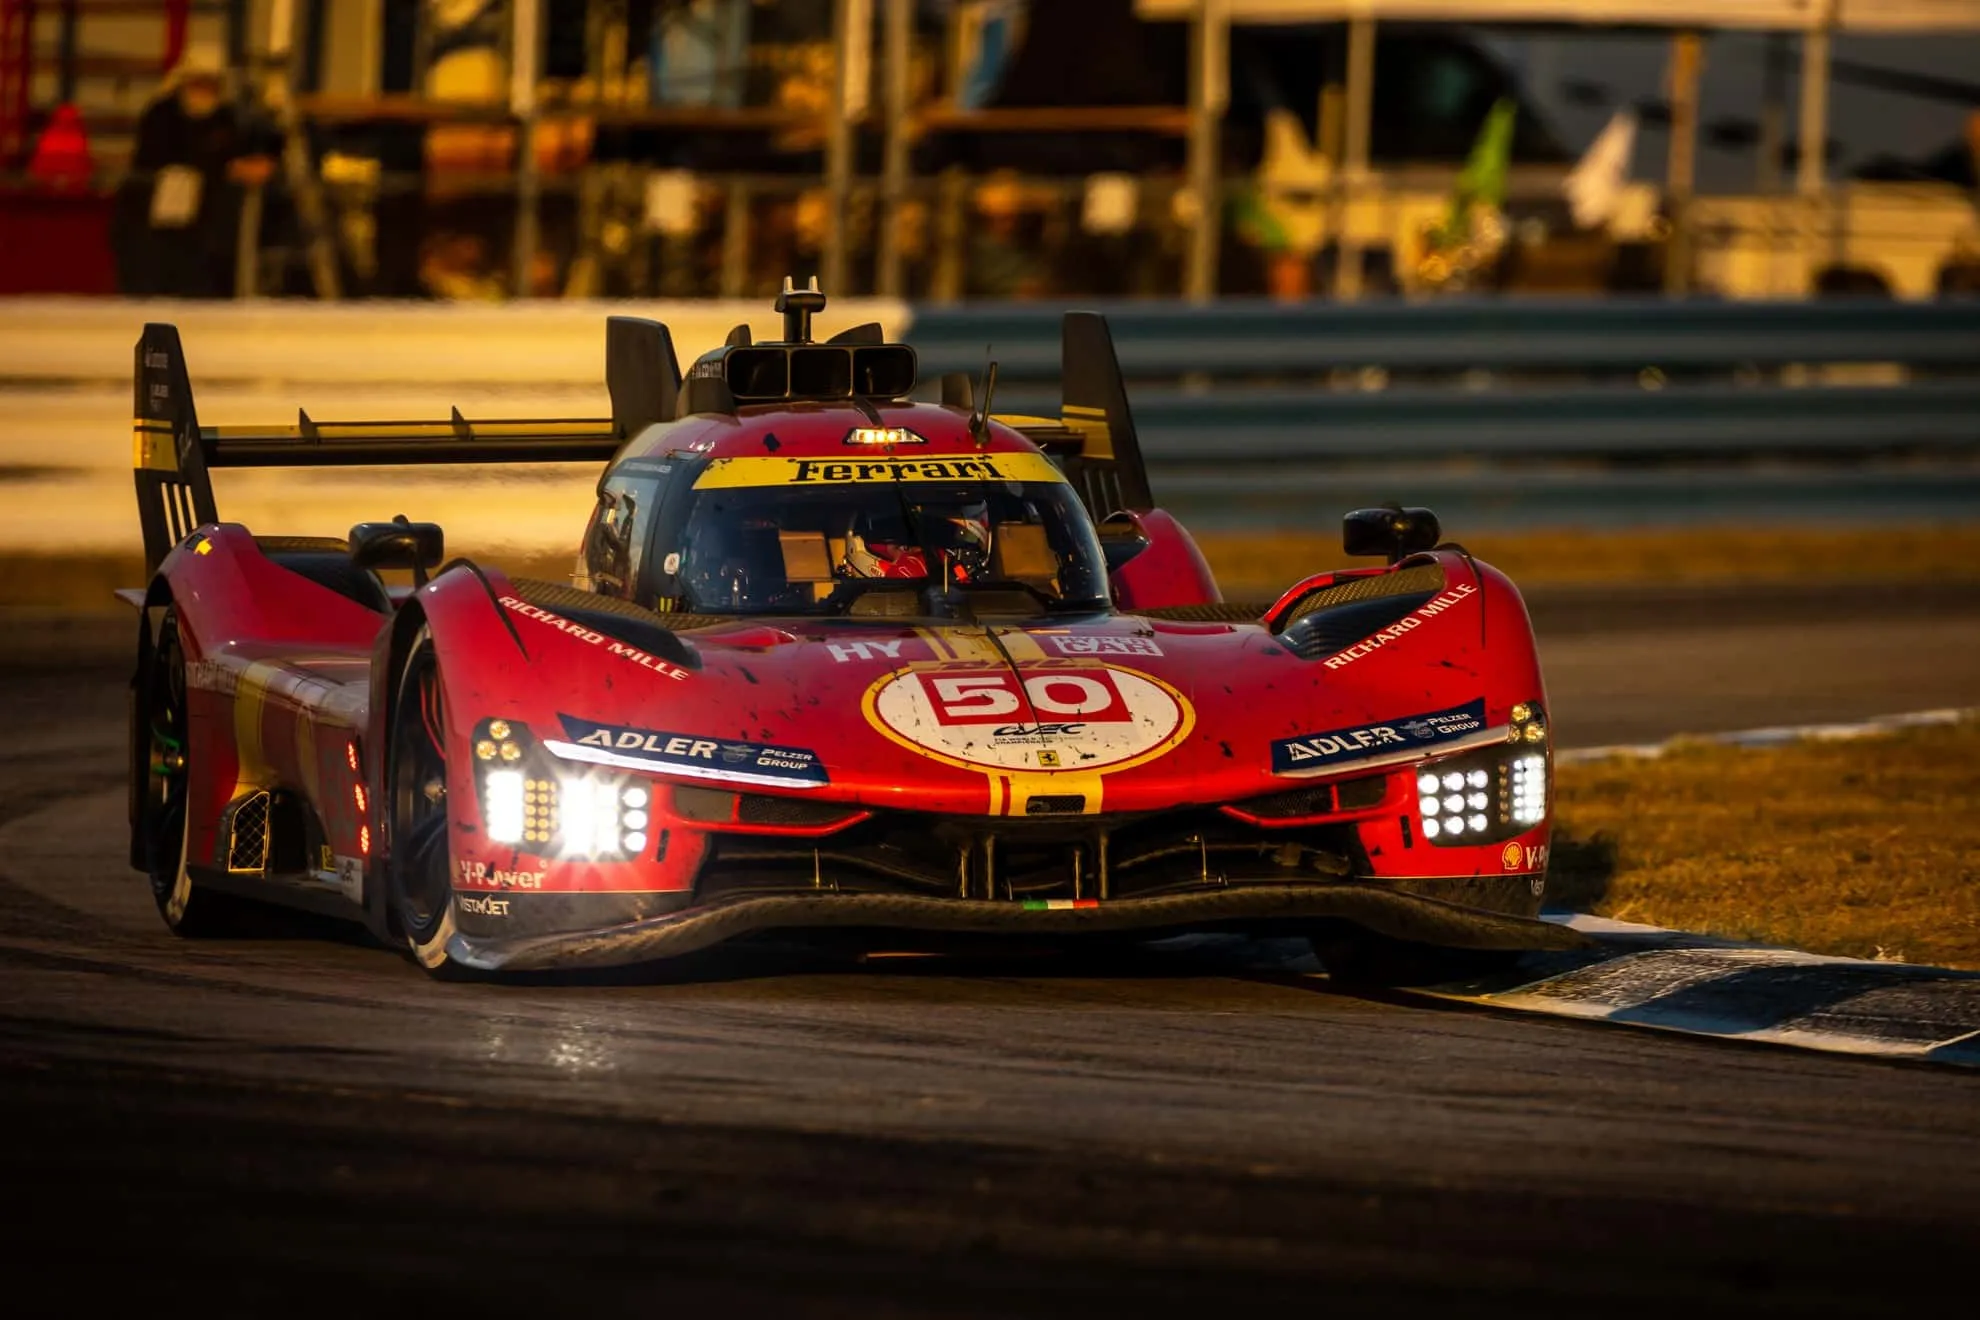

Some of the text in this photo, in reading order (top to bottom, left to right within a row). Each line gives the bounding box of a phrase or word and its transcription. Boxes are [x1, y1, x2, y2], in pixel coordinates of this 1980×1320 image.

[788, 457, 1005, 482] Ferrari
[498, 596, 689, 681] RICHARD MILLE
[1323, 583, 1478, 670] RICHARD MILLE
[826, 640, 902, 663] HY
[931, 675, 1113, 718] 50
[1428, 712, 1473, 726] PELZER
[1437, 719, 1481, 735] GROUP
[577, 729, 719, 759] ADLER
[761, 748, 813, 761] PELZER
[1285, 725, 1407, 761] ADLER
[756, 757, 809, 770] GROUP
